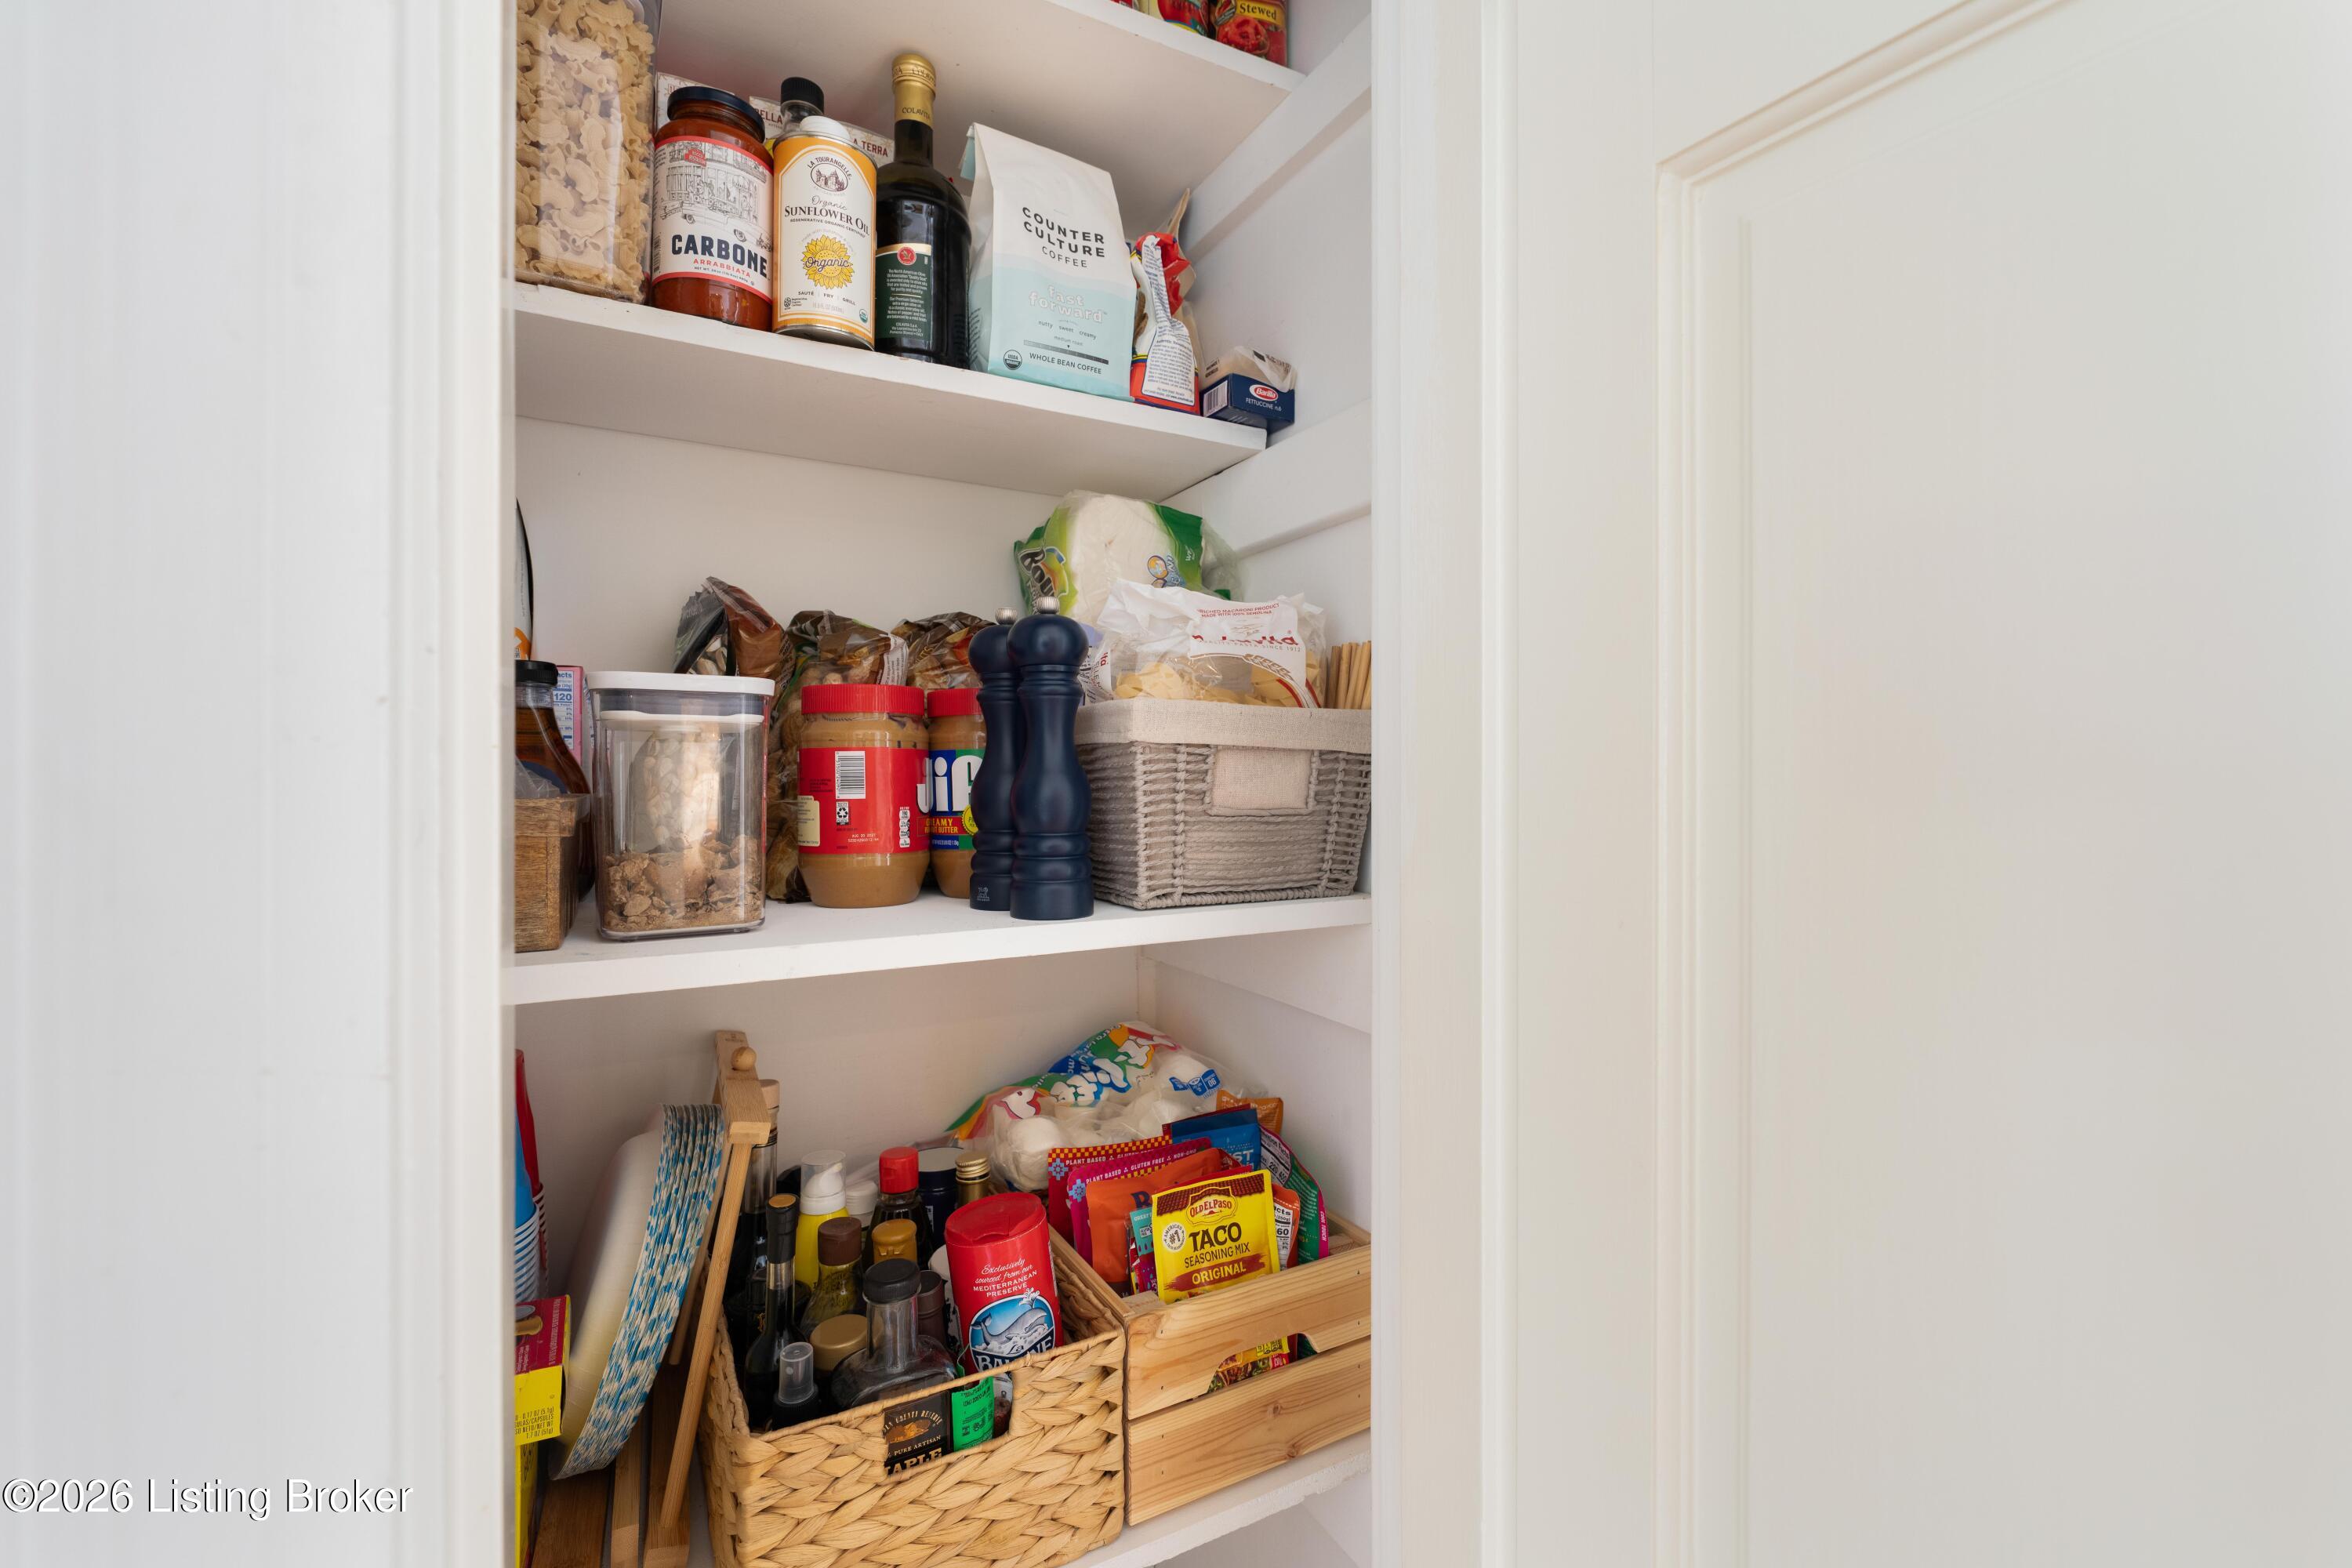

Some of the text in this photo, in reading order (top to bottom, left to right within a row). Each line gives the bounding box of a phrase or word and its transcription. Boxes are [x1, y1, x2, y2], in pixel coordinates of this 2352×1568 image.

[1240, 3, 1276, 20] Stewed
[861, 140, 887, 157] TERRA
[815, 157, 852, 180] TOURANGELLE
[811, 194, 848, 211] Organic
[785, 205, 869, 236] SUNFLOWER OIL
[1022, 207, 1105, 244] COUNTER
[1024, 221, 1105, 257] CULTURE
[672, 234, 767, 278] CARBONE
[805, 256, 850, 273] Organic
[1042, 246, 1087, 267] COFFEE
[693, 259, 750, 278] ARRABBIATA
[1048, 285, 1083, 306] fast
[1029, 292, 1102, 323] forward
[1038, 320, 1053, 328] nutty
[1079, 331, 1096, 339] creamy
[1029, 353, 1102, 375] WHOLE BEAN COFFEE
[1256, 387, 1276, 397] Barilla
[1246, 397, 1273, 409] FETTUCCINE
[1105, 1170, 1122, 1179] BASED
[1131, 1160, 1151, 1171] GLUTEN
[1189, 1221, 1242, 1253] TACO
[1184, 1242, 1250, 1269] SEASONING MIX
[975, 1265, 1033, 1284] sourced from our
[982, 1258, 1025, 1276] Exclusively
[1192, 1261, 1246, 1284] ORIGINAL
[973, 1271, 1038, 1292] MEDITERRANEAN
[986, 1283, 1028, 1298] PRESERVE
[1006, 1344, 1025, 1356] La
[894, 1435, 941, 1456] PURE ARTISAN
